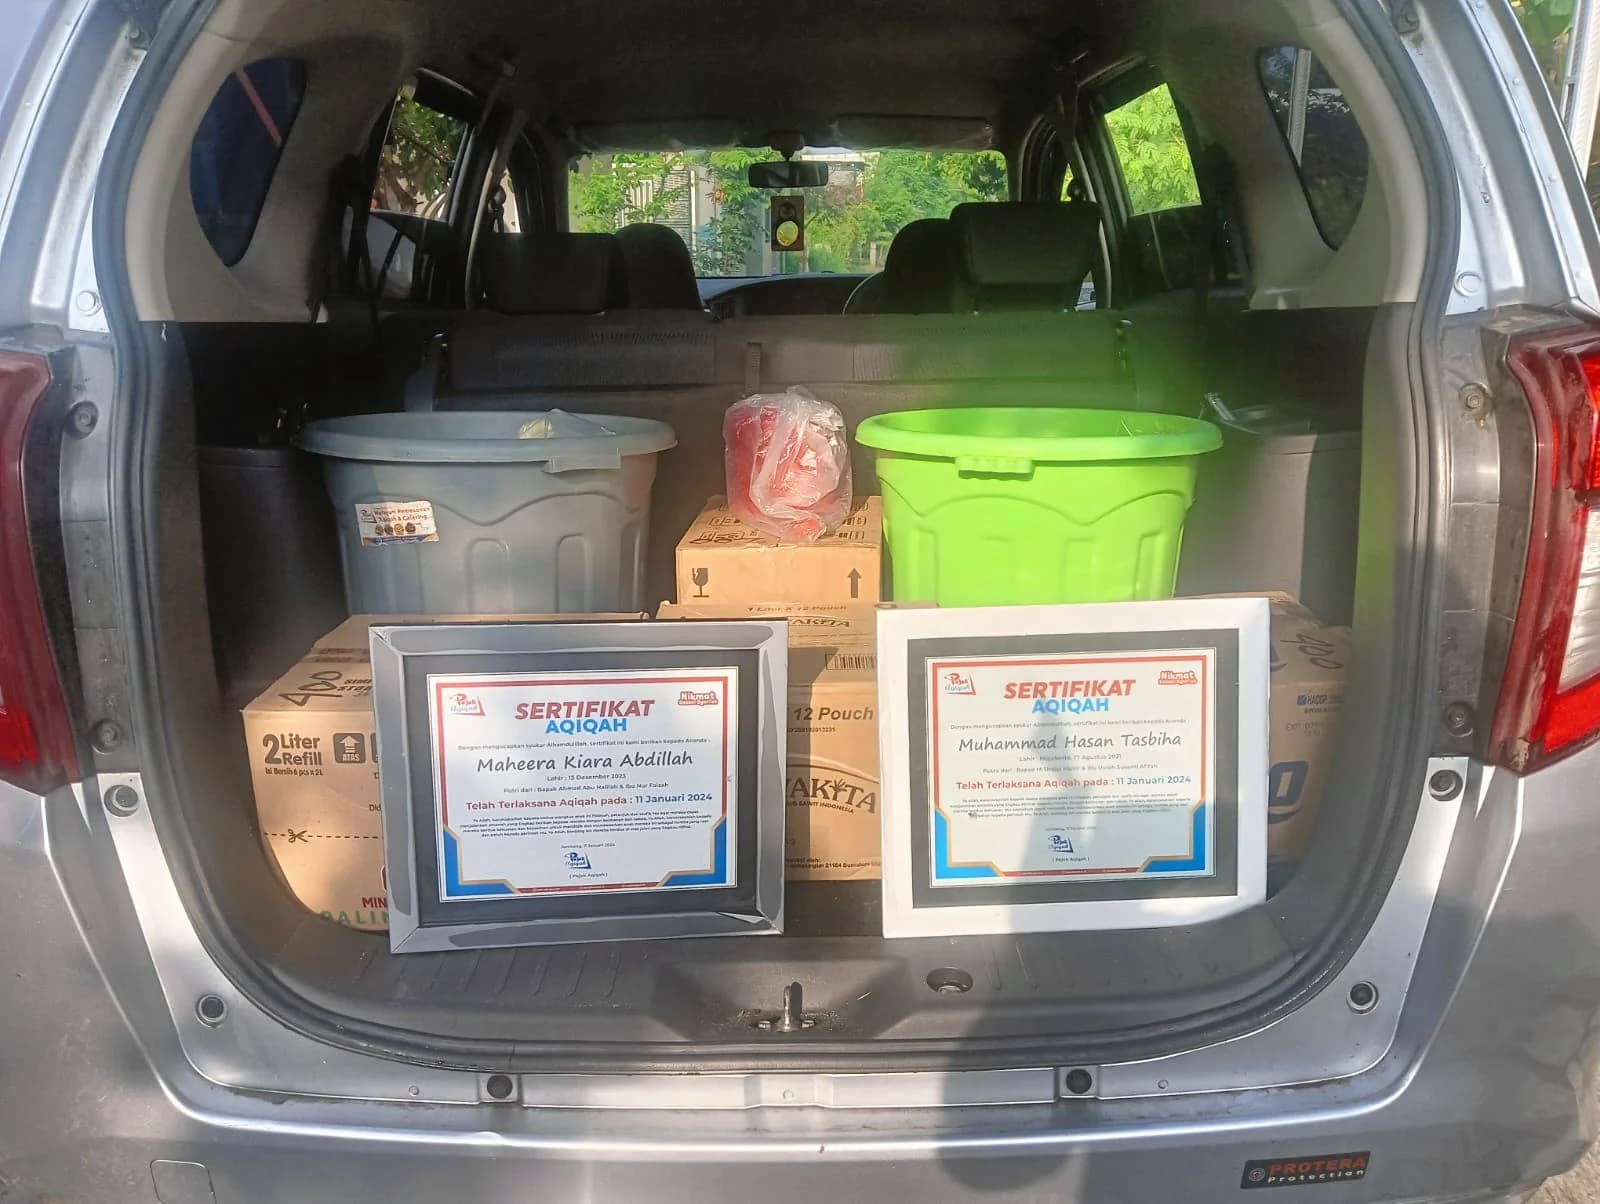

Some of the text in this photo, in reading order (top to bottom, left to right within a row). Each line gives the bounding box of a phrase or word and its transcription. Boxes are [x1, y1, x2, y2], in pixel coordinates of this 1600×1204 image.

[1003, 679, 1136, 699] SERTIFIKAT
[515, 699, 655, 720] SERTIFIKAT
[794, 707, 874, 720] 12 Pouch
[1032, 697, 1109, 714] AQIQAH
[545, 718, 627, 735] AQIQAH
[263, 734, 282, 764] 2
[280, 733, 320, 749] Liter
[959, 731, 1181, 751] Muhammad Hasan Tasbiha
[282, 752, 322, 766] Refill
[477, 751, 693, 772] Maheera Kiara Abdillah
[956, 782, 984, 790] Telah
[987, 780, 1041, 789] Terlaksana
[1044, 778, 1080, 788] Aqiqah
[1083, 778, 1109, 788] pada
[1127, 776, 1164, 785] Januari
[1167, 775, 1191, 783] 2024
[467, 802, 495, 810] Telah
[498, 799, 556, 808] Terlaksana
[560, 797, 598, 808] Aqiqah
[601, 797, 627, 806] pada
[645, 794, 685, 803] Januari
[688, 793, 713, 801] 2024
[820, 802, 854, 814] INDONESIA
[1269, 1157, 1366, 1175] PROTERA
[1268, 1168, 1364, 1183] protection
